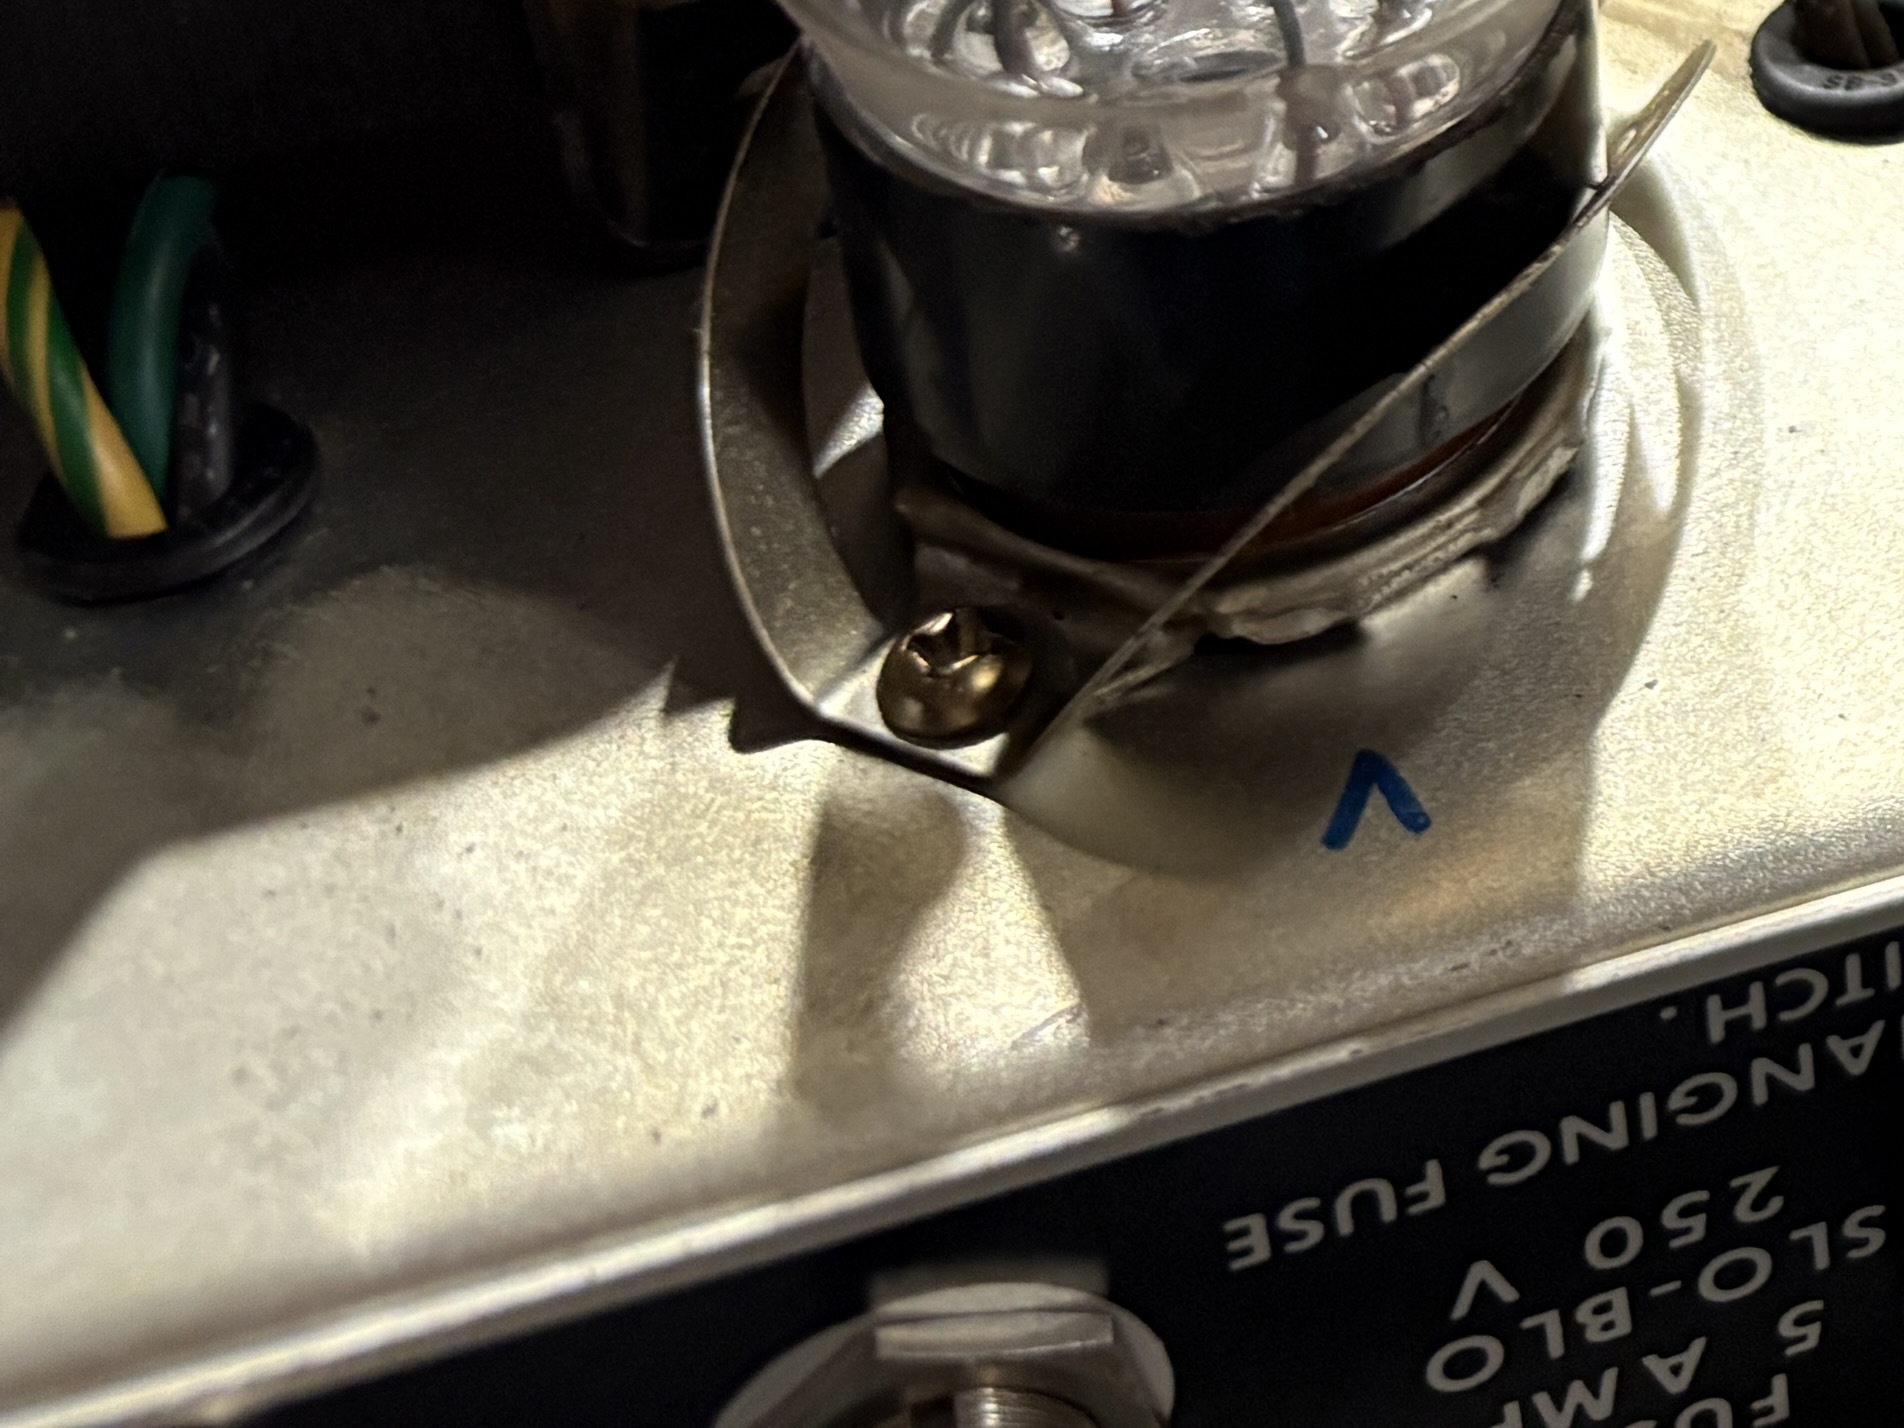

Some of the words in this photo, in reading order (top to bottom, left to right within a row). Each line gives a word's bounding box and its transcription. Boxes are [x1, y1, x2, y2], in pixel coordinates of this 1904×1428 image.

[1223, 1159, 1446, 1272] FUSE
[1584, 1165, 1784, 1270] 250
[1425, 1205, 1886, 1392] SLO-BLO
[1451, 1260, 1520, 1321] V
[1778, 1300, 1824, 1357] 5
